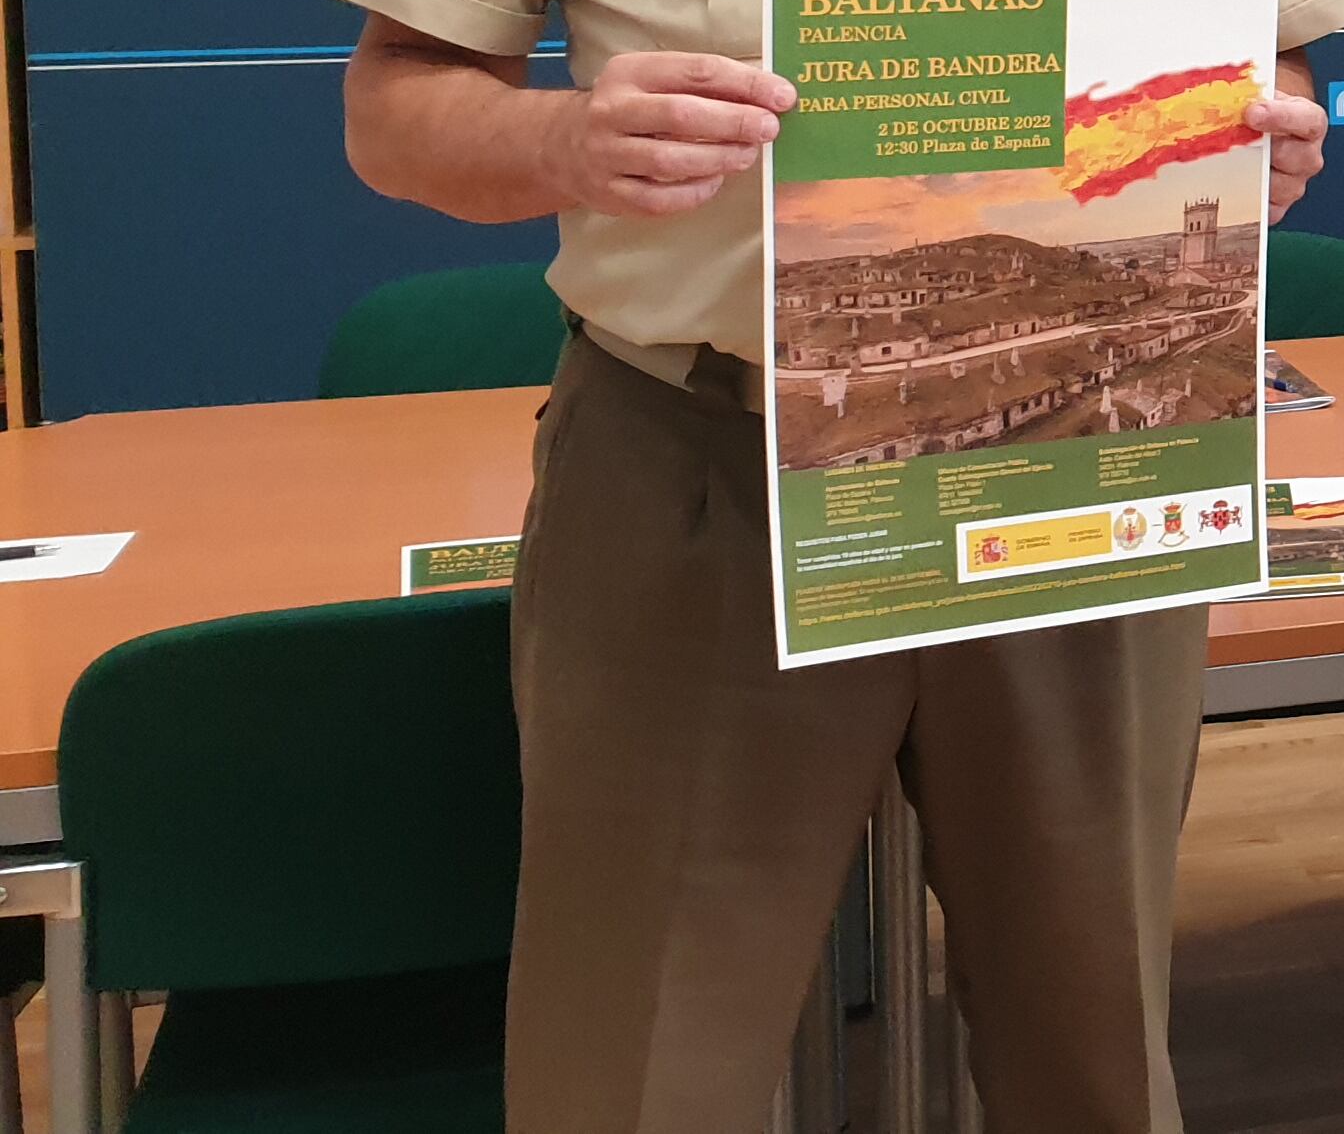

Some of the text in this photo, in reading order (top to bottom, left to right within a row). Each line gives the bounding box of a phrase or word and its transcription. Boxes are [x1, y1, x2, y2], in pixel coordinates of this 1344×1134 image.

[799, 25, 907, 43] PALENCIA
[797, 53, 1062, 83] JURA DE BANDERA
[799, 89, 1010, 113] PARA PERSONAL CIVIL
[878, 115, 1052, 137] 2 DE OCTUBRE 2022
[876, 134, 1051, 156] 12:30 Plaza de España
